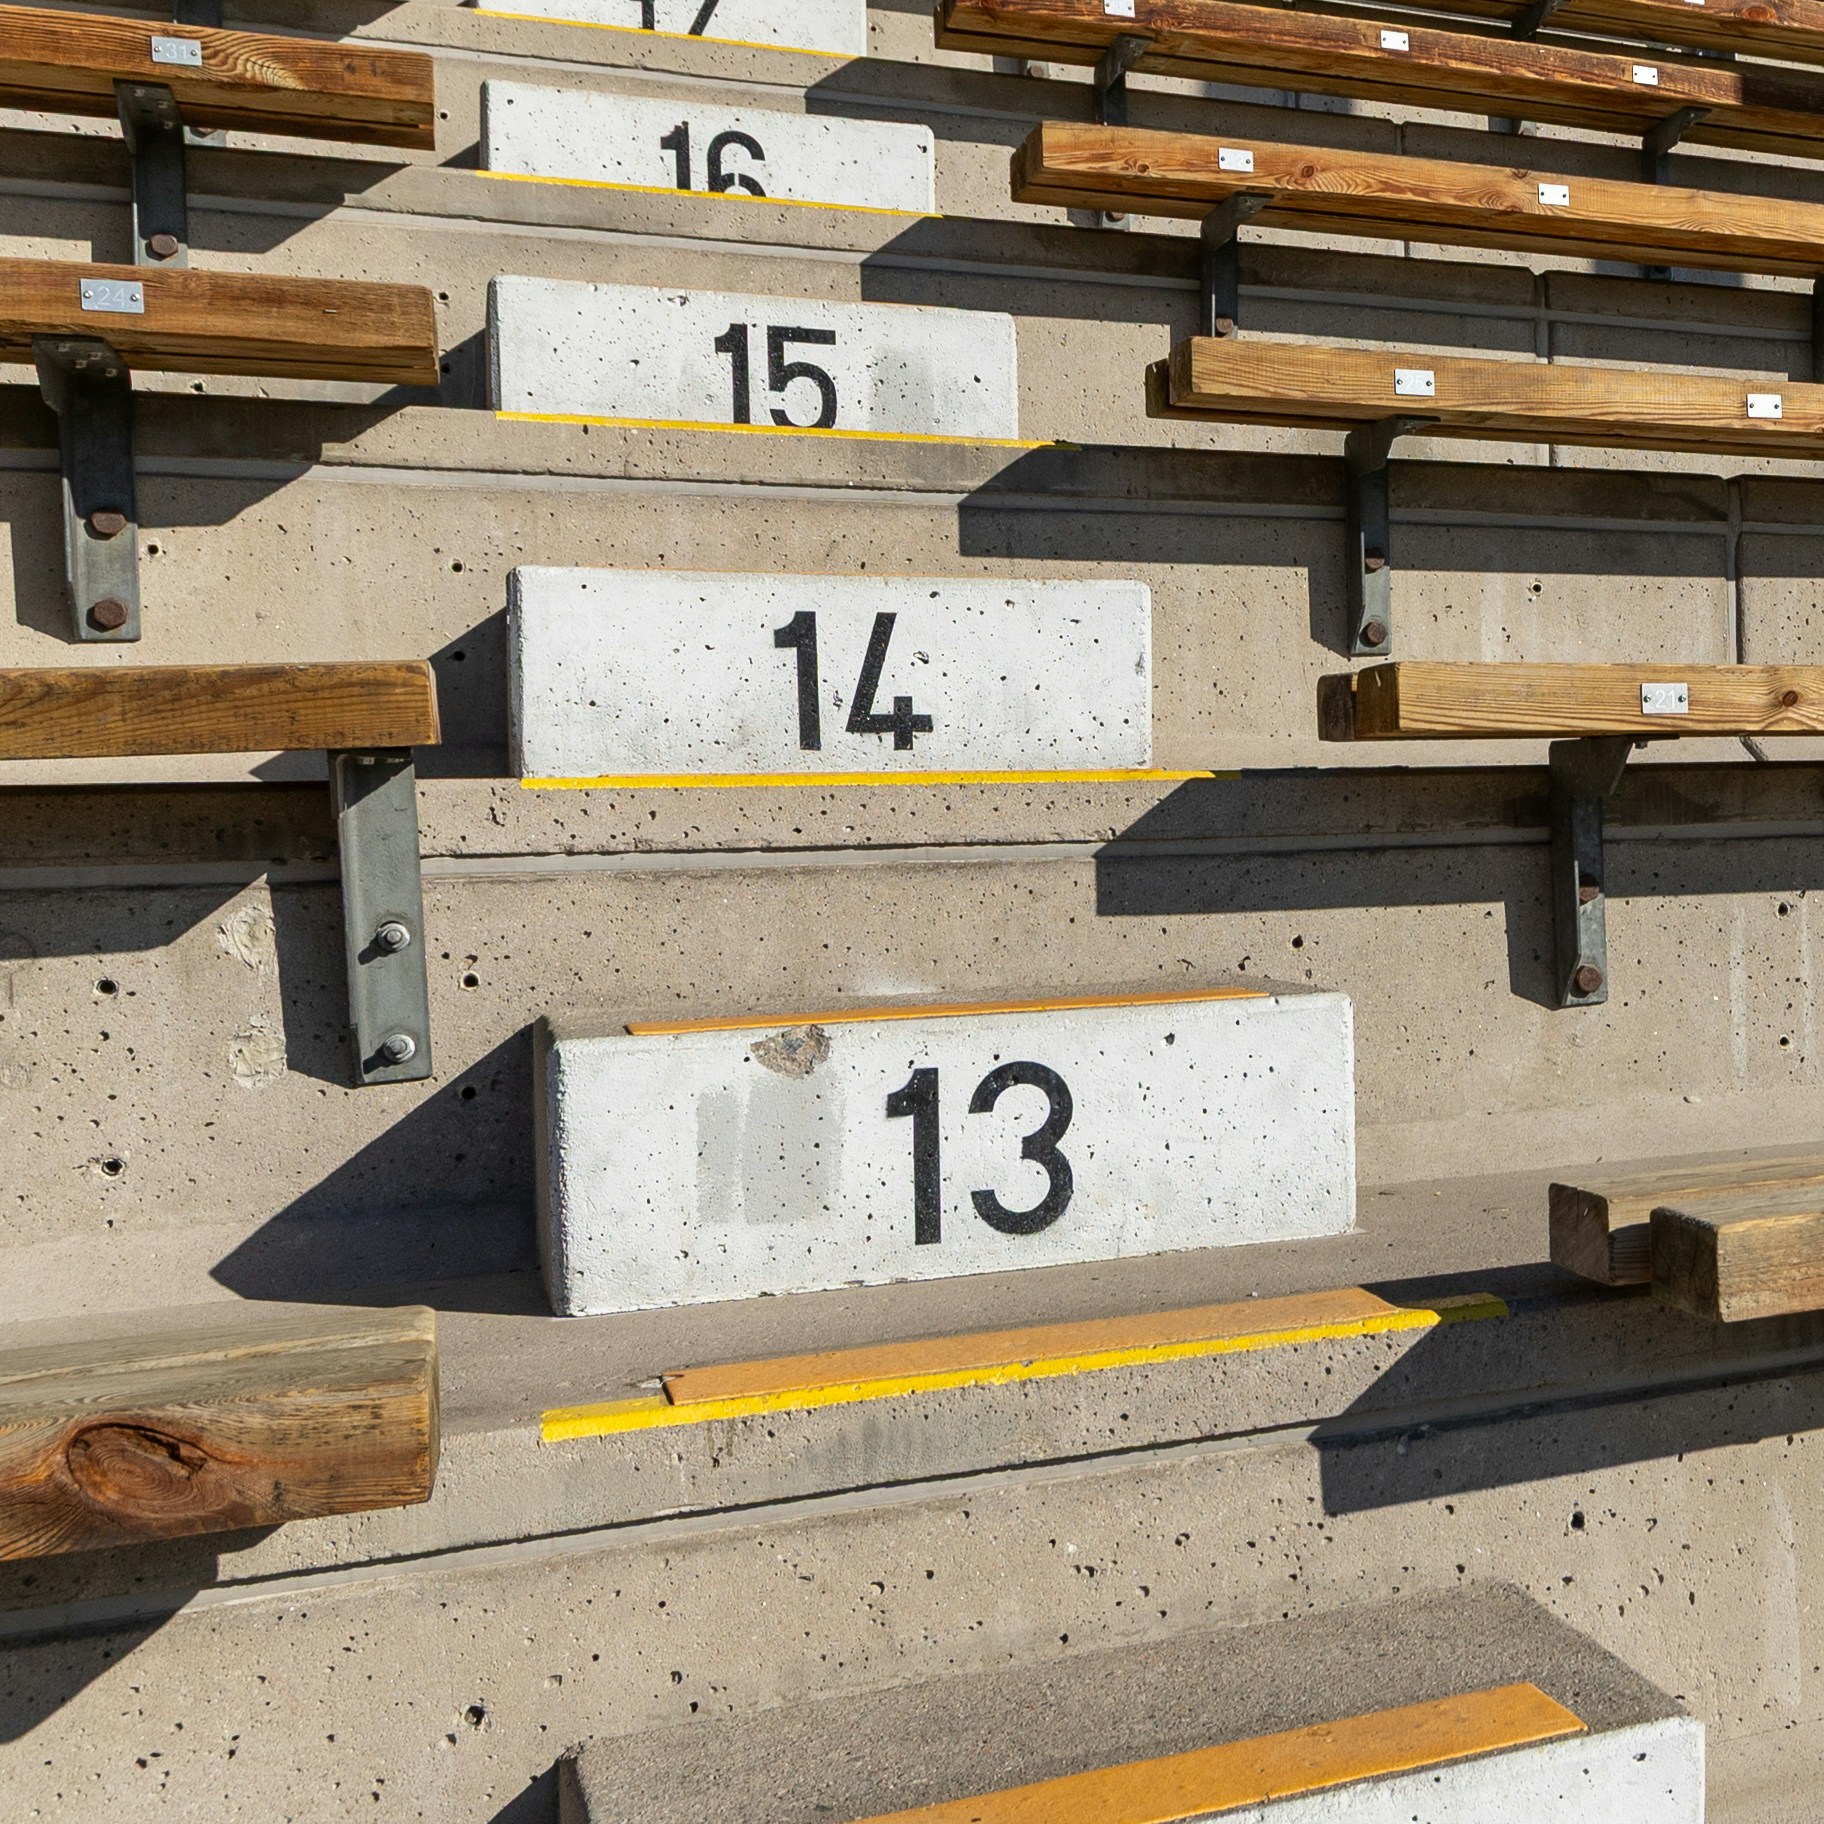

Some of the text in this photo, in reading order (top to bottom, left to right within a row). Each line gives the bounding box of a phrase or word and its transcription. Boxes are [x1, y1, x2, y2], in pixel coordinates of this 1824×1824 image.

[166, 43, 188, 60] 31
[660, 121, 767, 198] 16
[96, 285, 126, 308] 24
[714, 322, 838, 430] 15
[1405, 374, 1425, 392] 25
[773, 610, 935, 752] 14
[1655, 690, 1677, 709] 21
[885, 1061, 1075, 1246] 13
